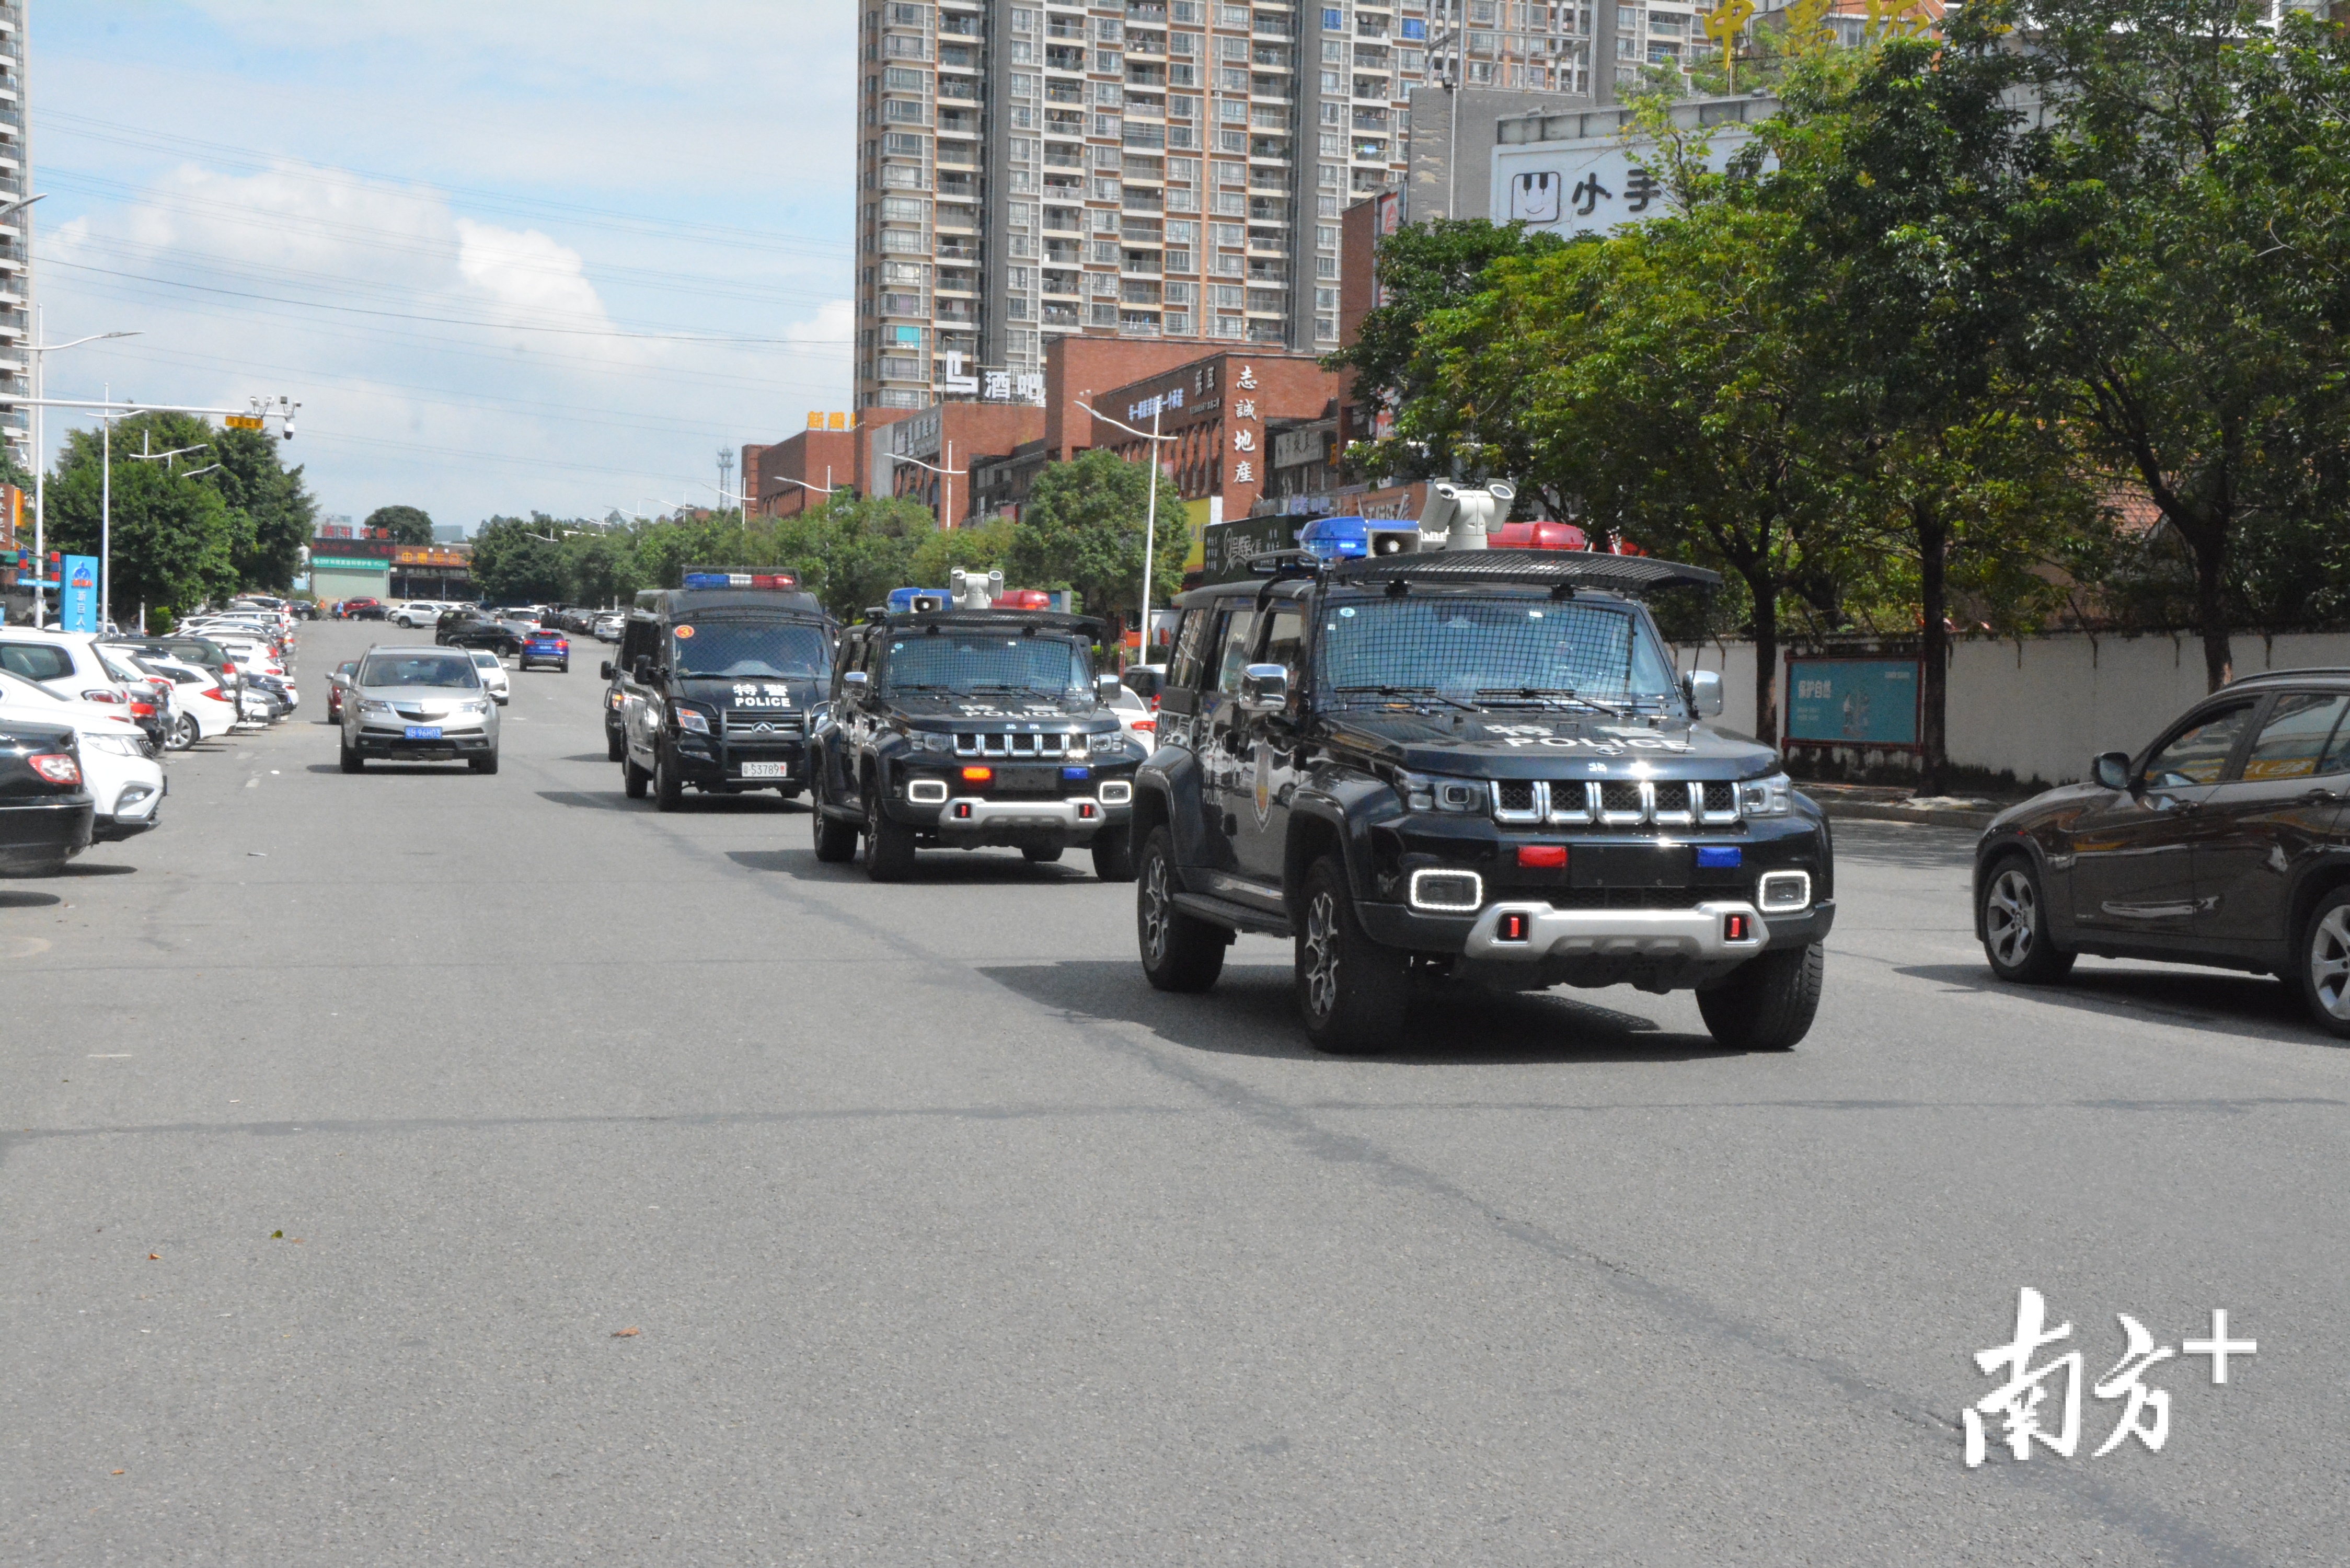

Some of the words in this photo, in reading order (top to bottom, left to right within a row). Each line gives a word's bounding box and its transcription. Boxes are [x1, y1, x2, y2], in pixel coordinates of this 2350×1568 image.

[984, 370, 1046, 400] 酒吧
[401, 552, 471, 565] 中惠车公
[680, 627, 689, 637] 3
[733, 684, 788, 697] 特警
[735, 697, 791, 707] POLICE
[1503, 737, 1696, 750] POLICE
